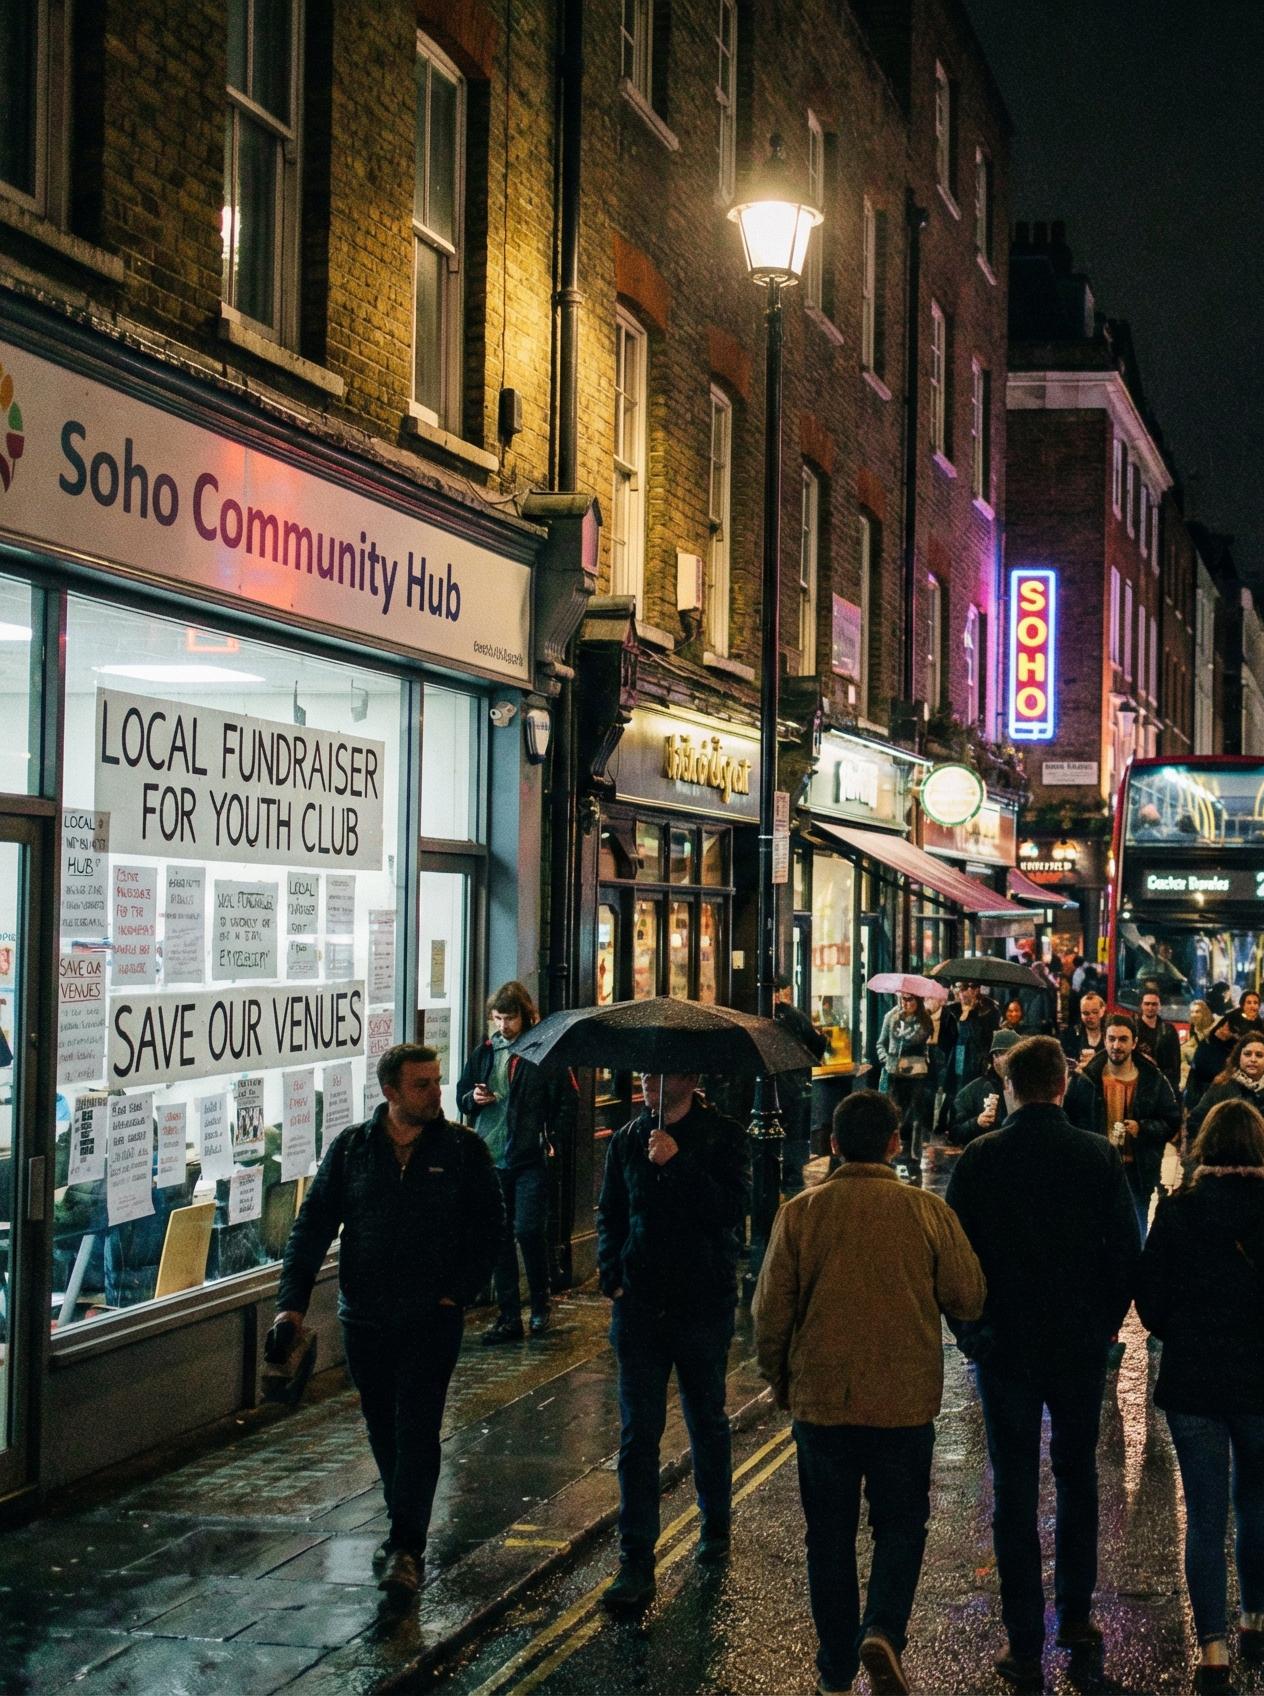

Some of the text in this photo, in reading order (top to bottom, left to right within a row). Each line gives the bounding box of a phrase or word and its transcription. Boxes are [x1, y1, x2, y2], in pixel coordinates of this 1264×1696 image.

[58, 419, 461, 622] Soho Community Hub
[1016, 580, 1047, 717] SOHO
[101, 699, 378, 799] LOCAL FUNDRAISER
[64, 815, 96, 831] LOCAL
[142, 783, 359, 856] FOR YOUTH CLUB
[67, 856, 94, 874] HUB
[60, 958, 85, 977] SAVE
[60, 982, 101, 999] VENUES
[113, 1003, 196, 1078] SAVE
[208, 999, 263, 1062] OUR
[272, 990, 362, 1054] VENUES
